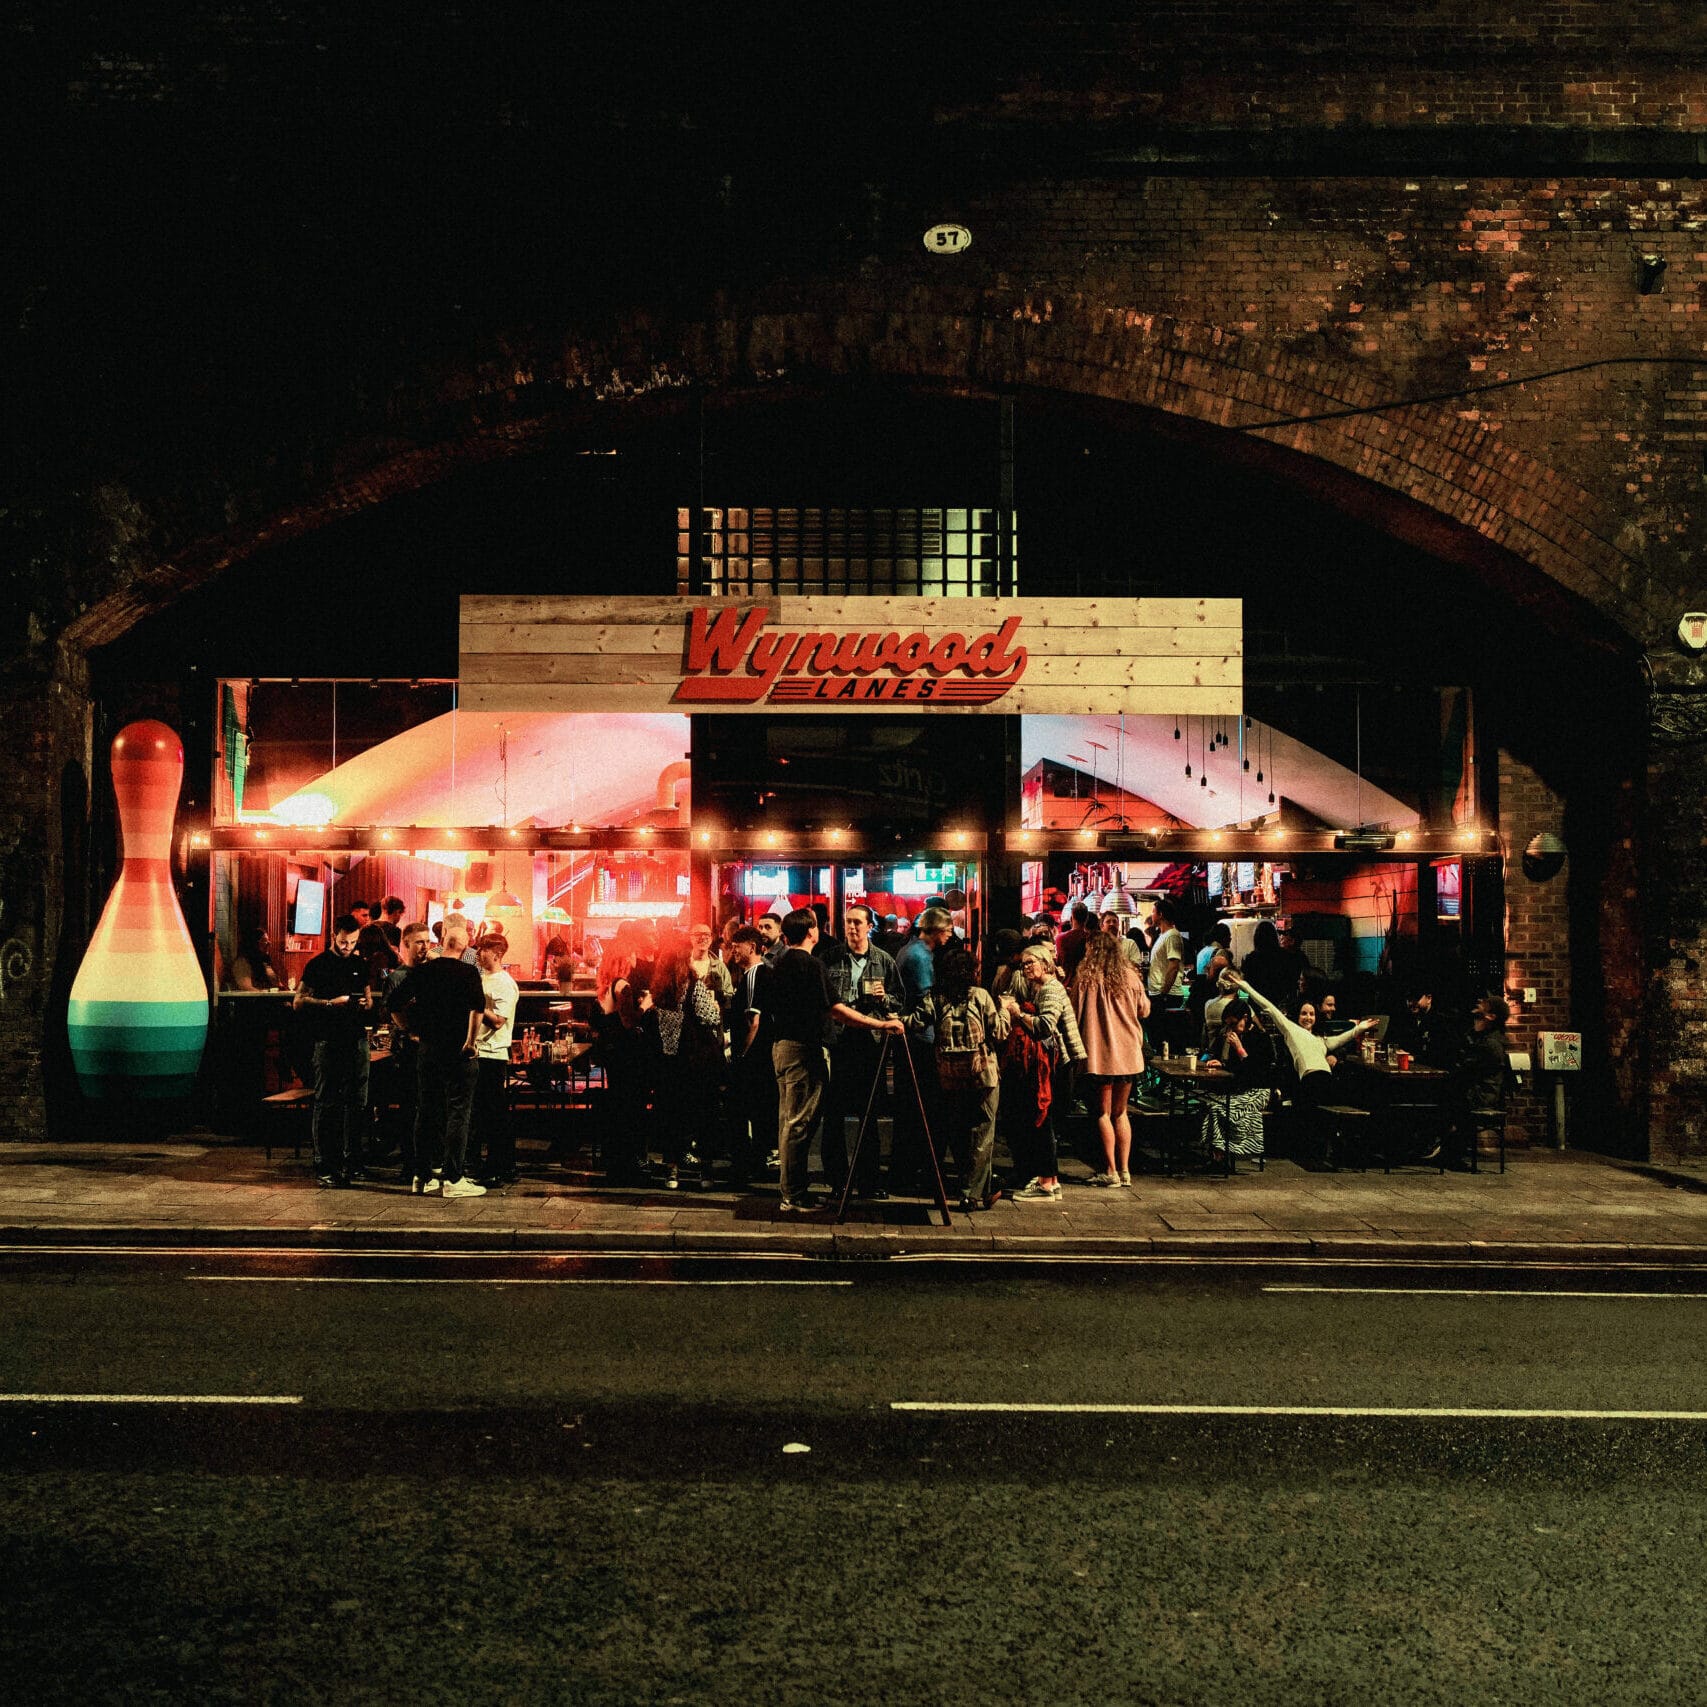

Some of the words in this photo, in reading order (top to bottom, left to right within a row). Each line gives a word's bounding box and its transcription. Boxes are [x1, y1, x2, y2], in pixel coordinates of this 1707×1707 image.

[936, 231, 959, 246] 57
[677, 606, 1027, 698] Wynwood
[815, 678, 938, 699] LANES
